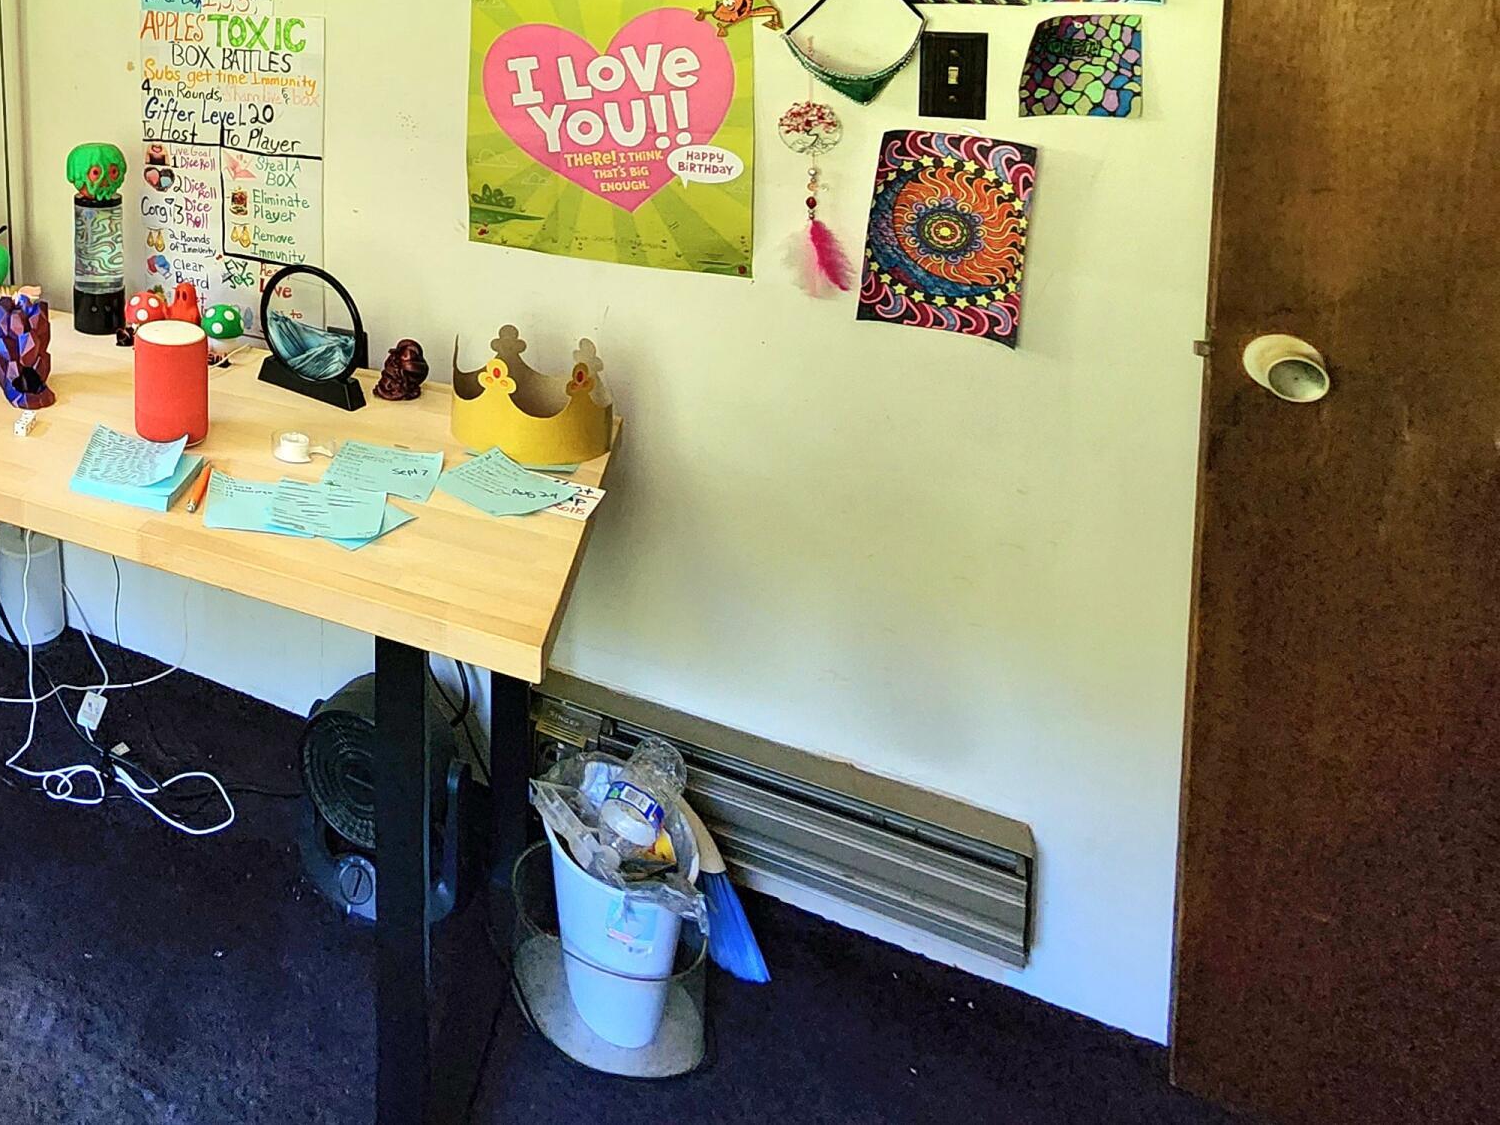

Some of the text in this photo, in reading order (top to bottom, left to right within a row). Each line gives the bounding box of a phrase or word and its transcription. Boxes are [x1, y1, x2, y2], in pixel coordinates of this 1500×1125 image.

[140, 10, 307, 53] APPLES TOXIC
[171, 43, 293, 73] BOX BATTLES
[143, 58, 317, 96] Subs get time Immunity
[507, 56, 544, 106] I
[141, 78, 152, 96] 4
[153, 87, 173, 98] min
[144, 97, 196, 124] Gifter
[248, 104, 274, 124] 20
[142, 120, 198, 144] To Host
[224, 128, 301, 154] To Player
[171, 155, 216, 171] 1 Dice Roll
[255, 155, 301, 172] Steal A
[619, 153, 627, 163] I
[173, 175, 207, 194] 2 Dice
[266, 172, 297, 188] BOX
[197, 187, 217, 200] Roll
[253, 189, 310, 208] Eliminate
[174, 204, 184, 224] 3
[184, 197, 212, 213] Dice
[254, 205, 297, 223] Player
[185, 213, 208, 229] Roll
[168, 229, 211, 245] 2 Rounds
[254, 225, 295, 245] Remove
[251, 243, 306, 263] Immunity
[173, 258, 205, 273] Clear
